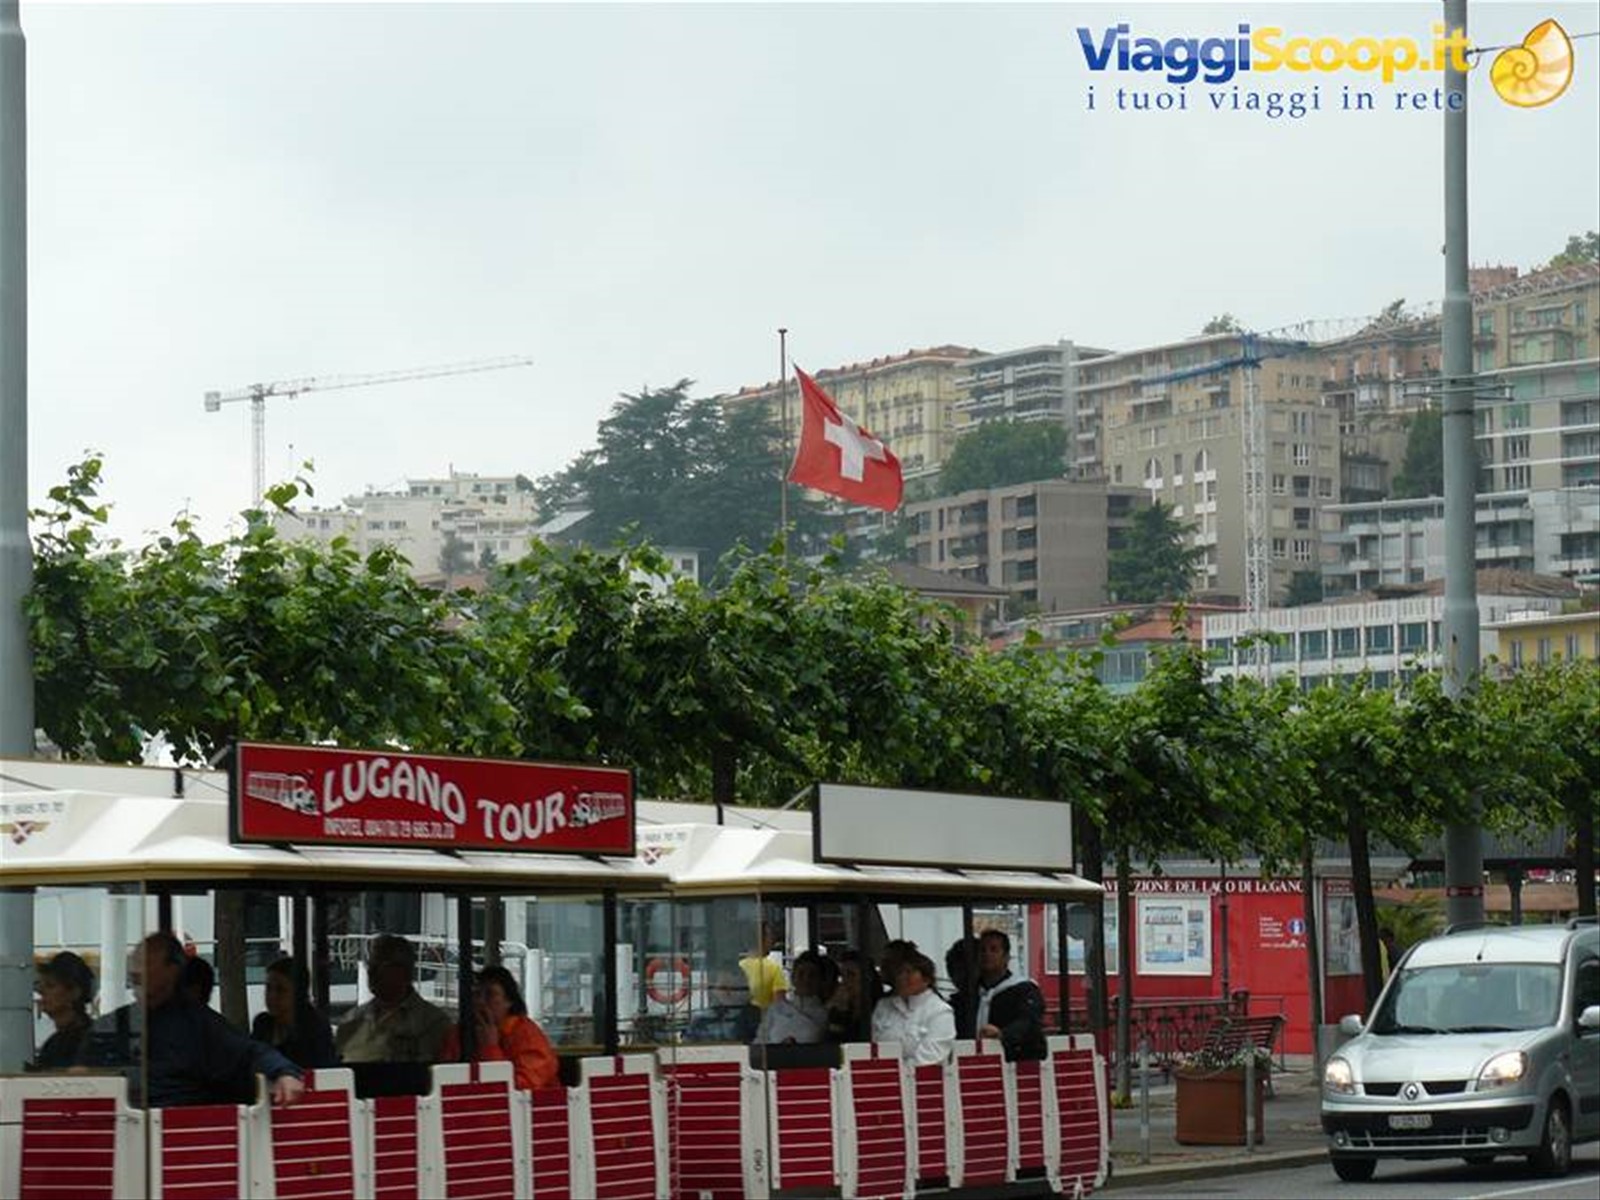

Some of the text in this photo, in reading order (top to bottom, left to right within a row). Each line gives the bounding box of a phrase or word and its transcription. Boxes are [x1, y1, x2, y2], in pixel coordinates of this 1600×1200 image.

[322, 757, 567, 842] LUGANO TOUR
[1238, 880, 1252, 893] DI
